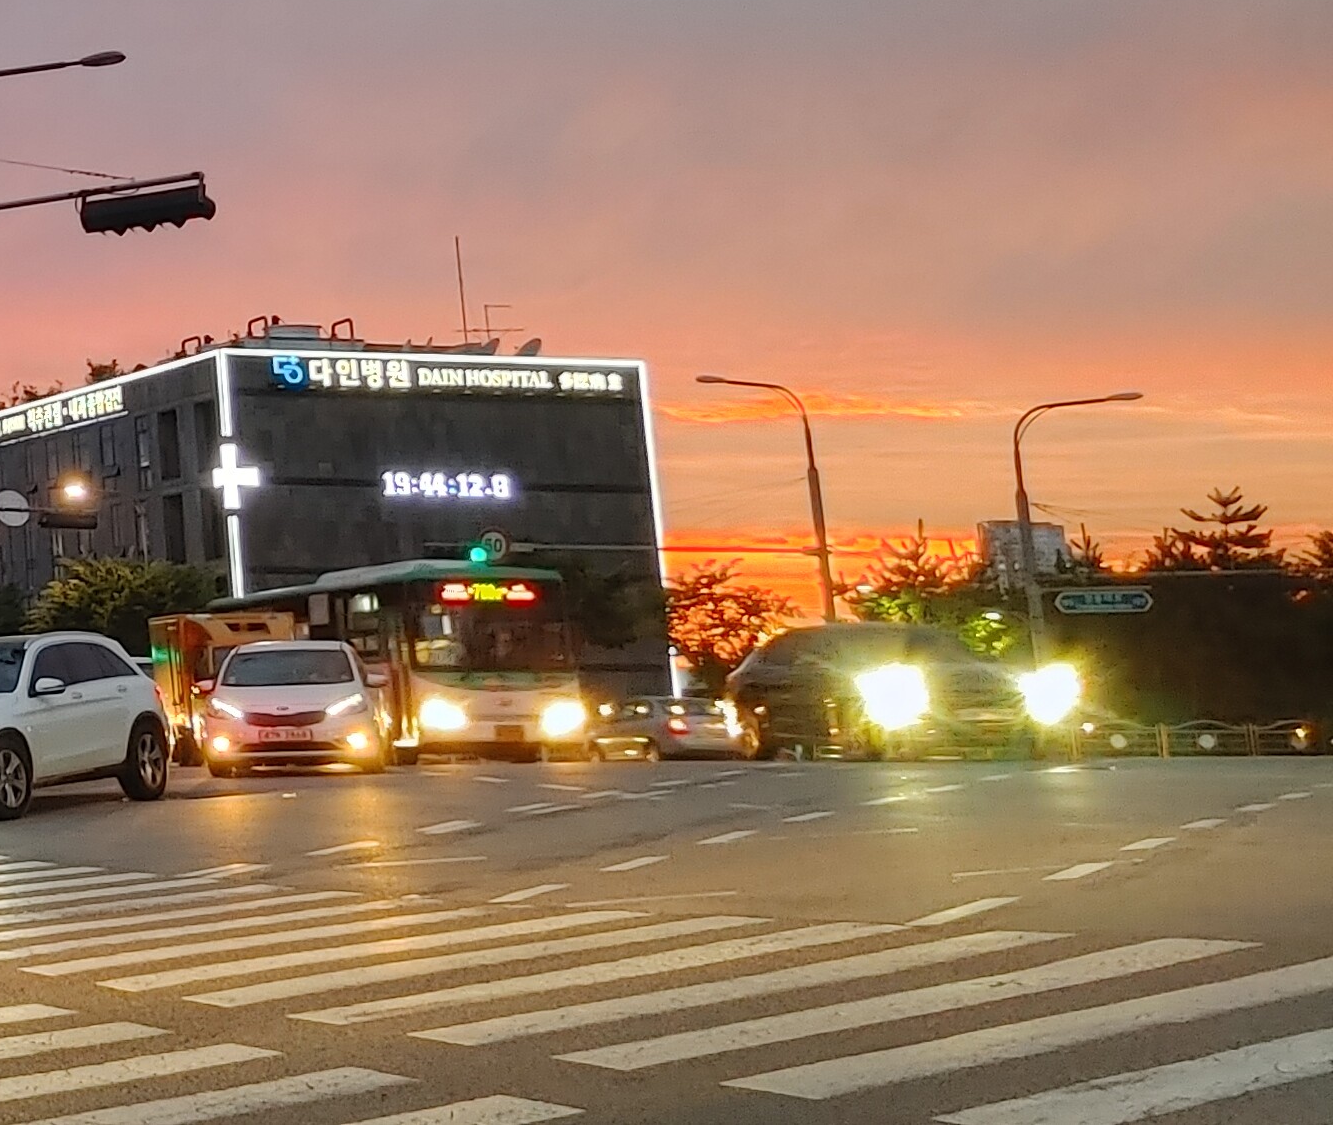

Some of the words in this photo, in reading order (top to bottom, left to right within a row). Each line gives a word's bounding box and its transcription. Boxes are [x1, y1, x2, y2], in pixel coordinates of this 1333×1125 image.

[308, 357, 412, 388] 다인병원
[417, 366, 464, 387] DAIN
[465, 368, 554, 389] HOSPITAL
[484, 538, 503, 553] 50
